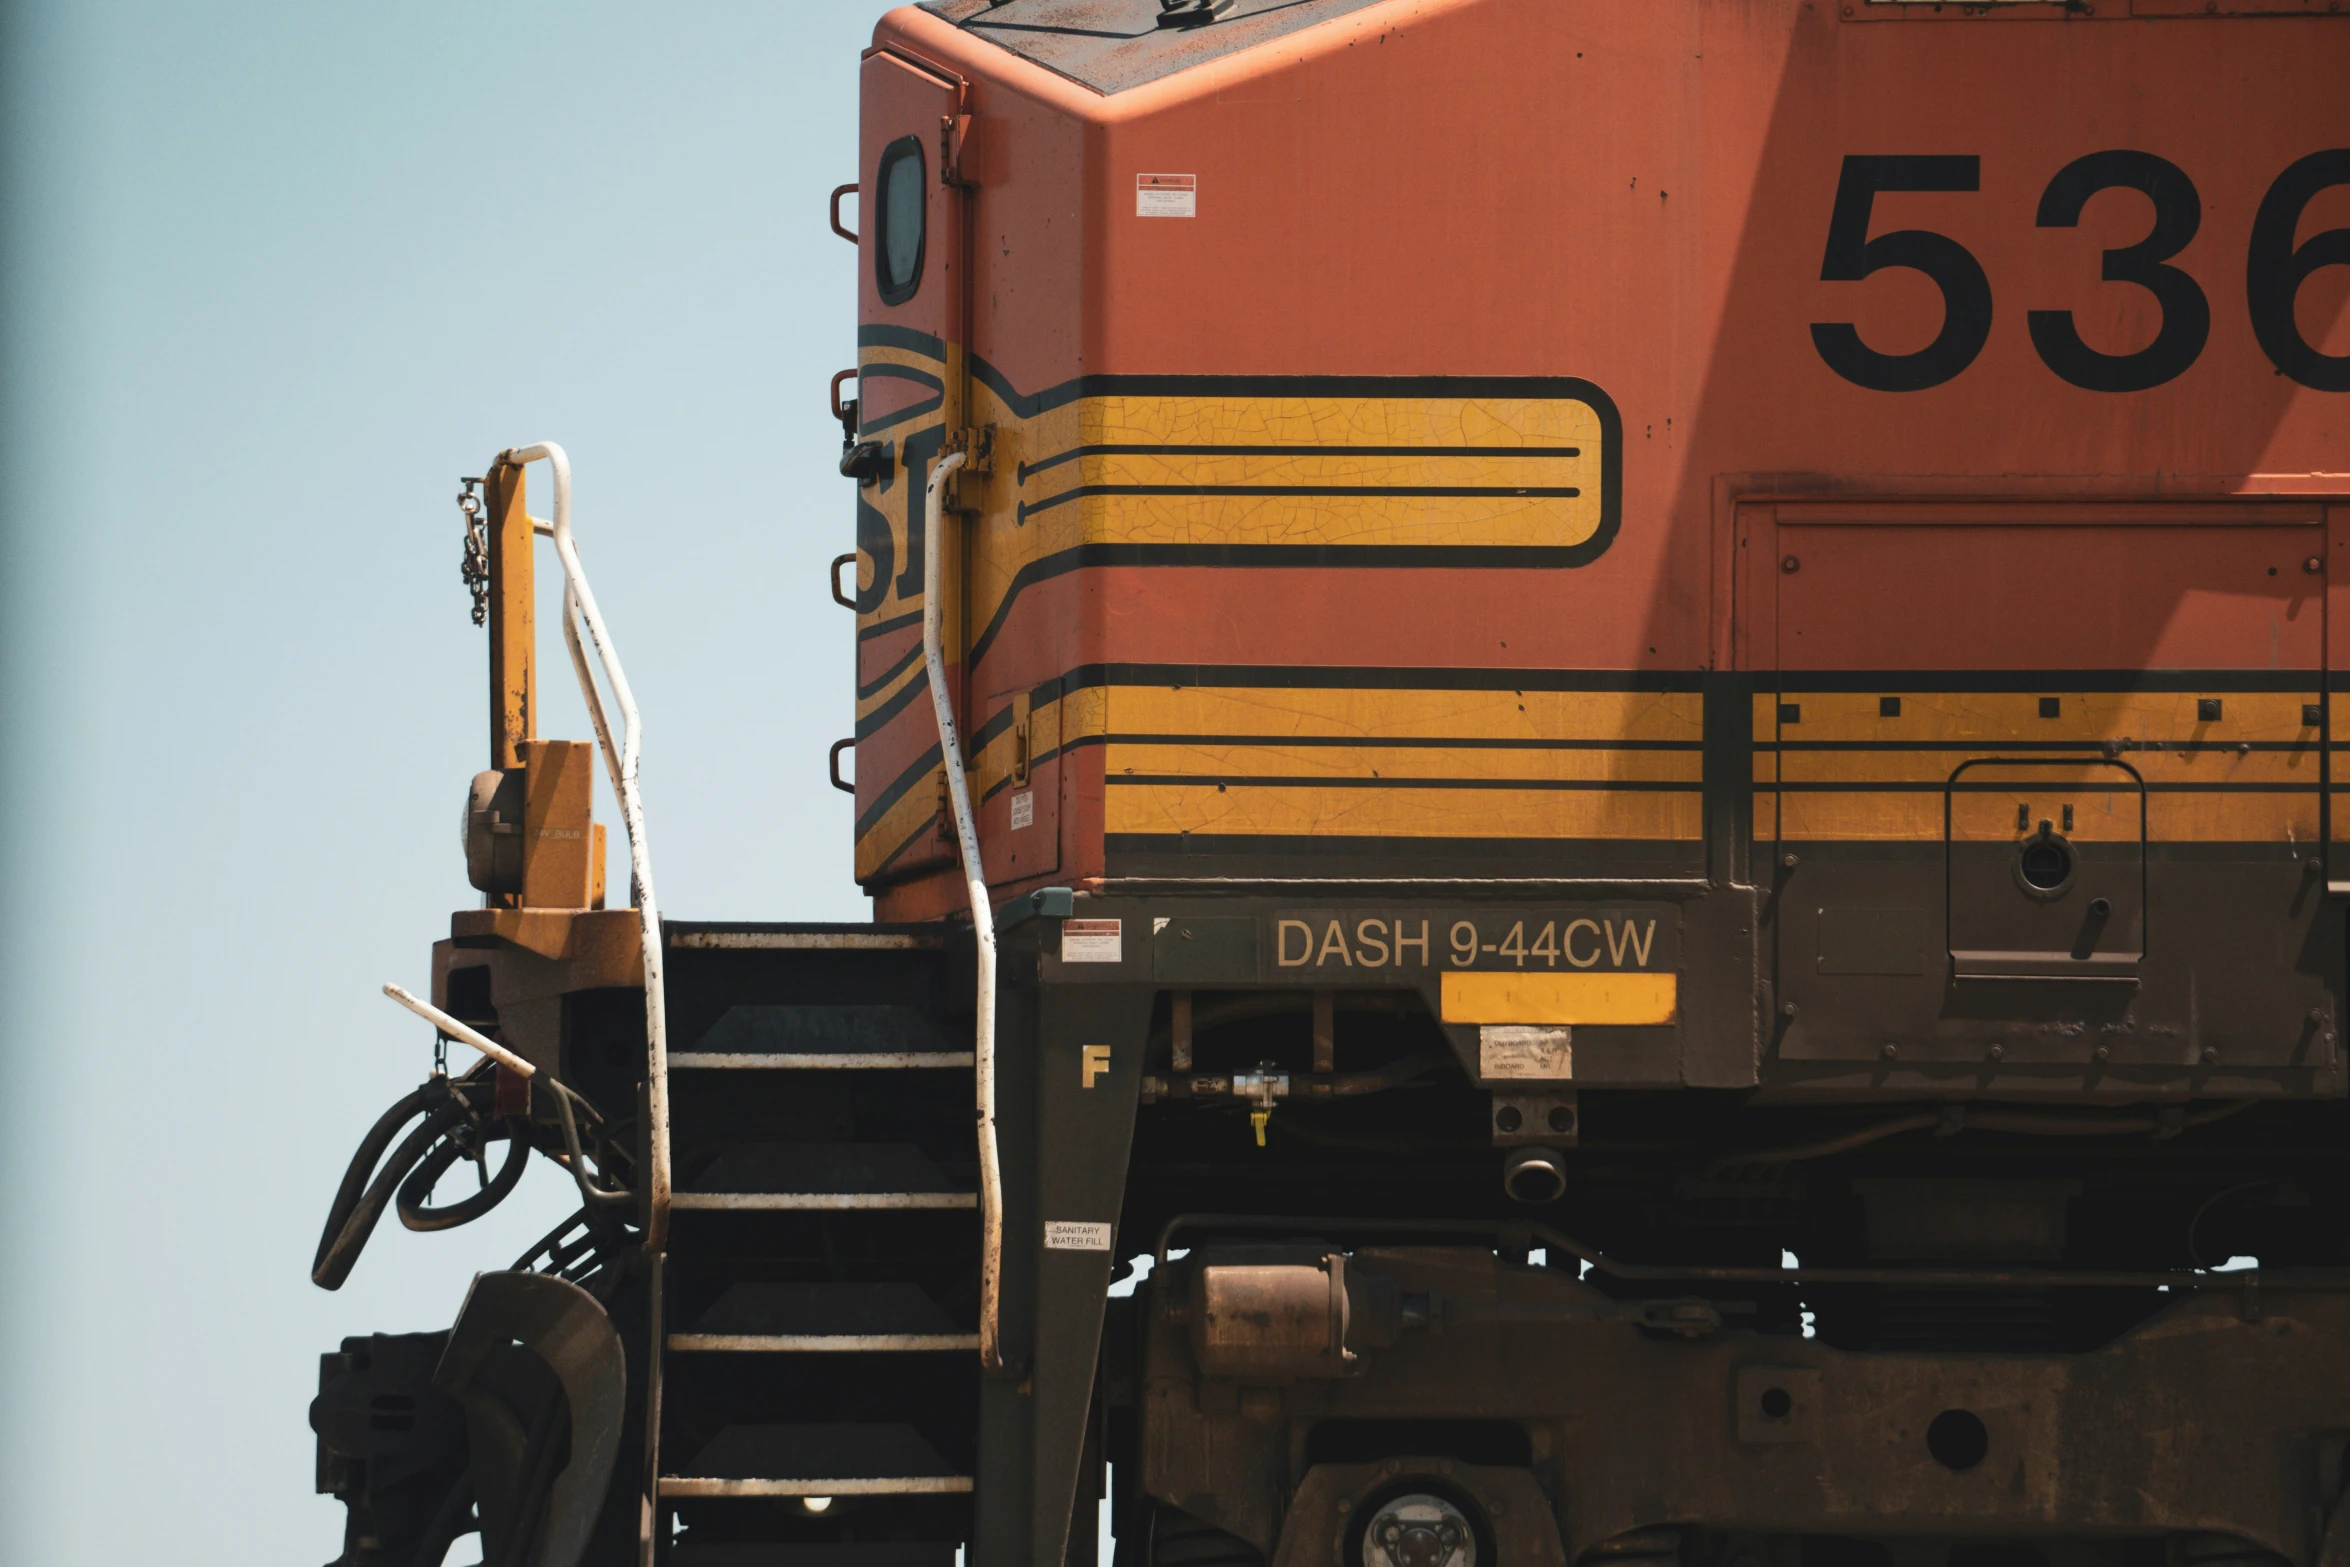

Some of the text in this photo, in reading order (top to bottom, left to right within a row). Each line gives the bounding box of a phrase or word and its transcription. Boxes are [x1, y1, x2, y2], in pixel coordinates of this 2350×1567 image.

[555, 829, 580, 839] BULB
[1277, 919, 1657, 968] DASH 9-44CW
[1082, 1044, 1111, 1089] F
[1056, 1226, 1100, 1235] SANITARY
[1051, 1236, 1084, 1245] WATER
[1085, 1237, 1104, 1246] FILL
